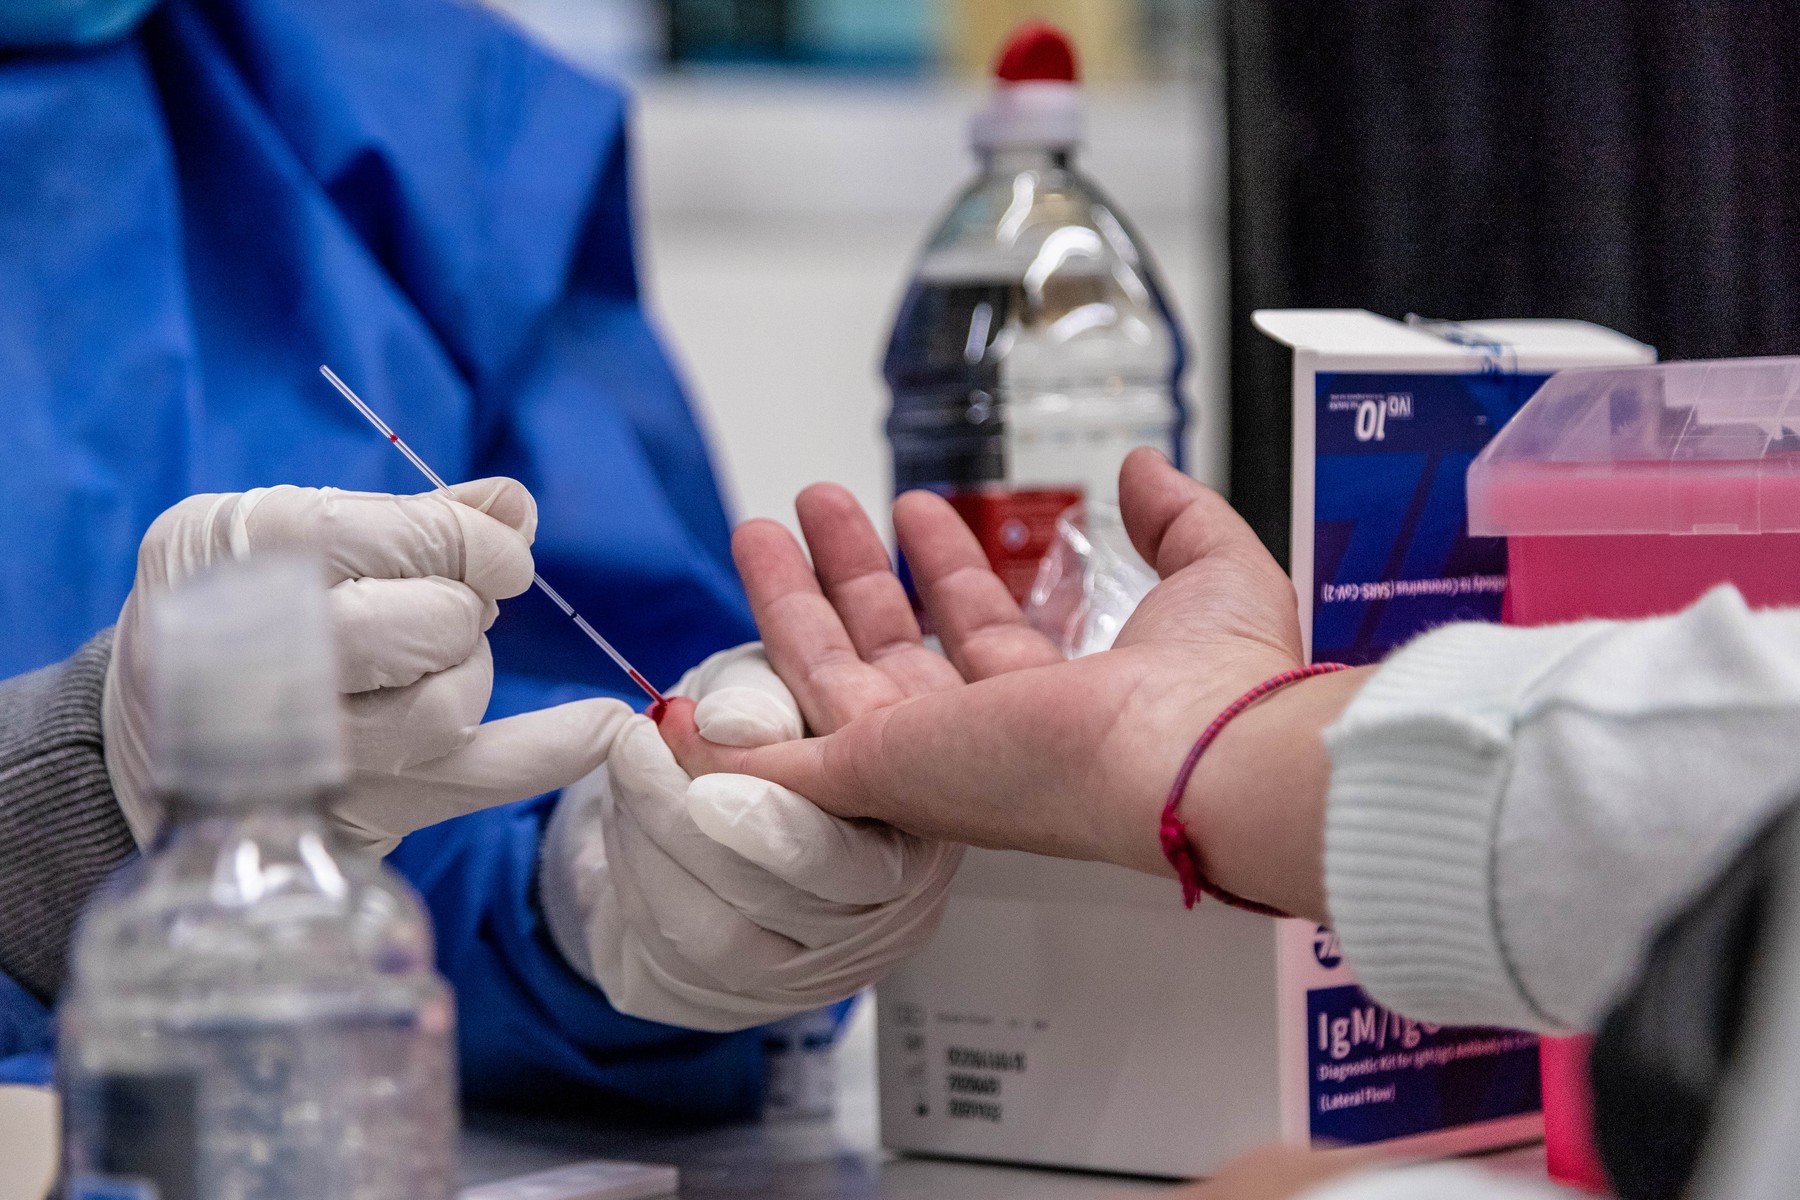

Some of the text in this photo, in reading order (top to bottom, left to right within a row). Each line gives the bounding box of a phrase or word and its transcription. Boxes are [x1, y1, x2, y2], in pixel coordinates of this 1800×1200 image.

[1387, 395, 1412, 417] IVD
[1355, 399, 1387, 441] 10
[1322, 579, 1395, 603] (SARS-CoV-2)
[1397, 576, 1459, 597] Coronavirus
[1317, 1057, 1379, 1083] Diagnostic
[1379, 1054, 1397, 1072] Kit
[1319, 1082, 1396, 1114] (Lateral Flow)
